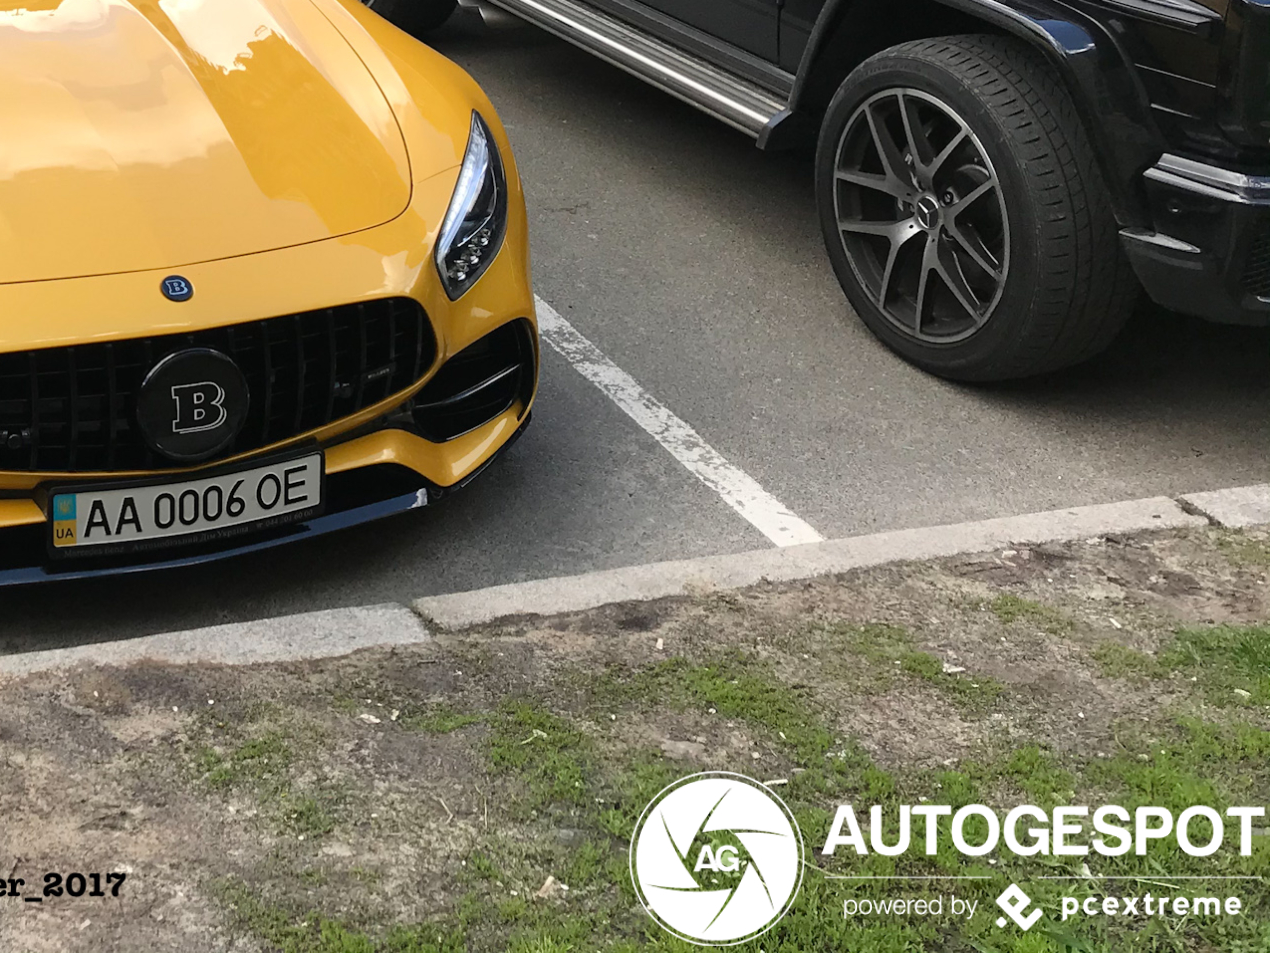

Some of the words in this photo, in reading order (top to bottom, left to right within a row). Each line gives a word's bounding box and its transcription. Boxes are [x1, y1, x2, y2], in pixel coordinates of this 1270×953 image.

[165, 279, 189, 295] B
[171, 381, 227, 434] B
[83, 496, 143, 538] AA
[154, 479, 246, 530] 0006
[256, 464, 308, 511] OE
[56, 528, 74, 539] UA
